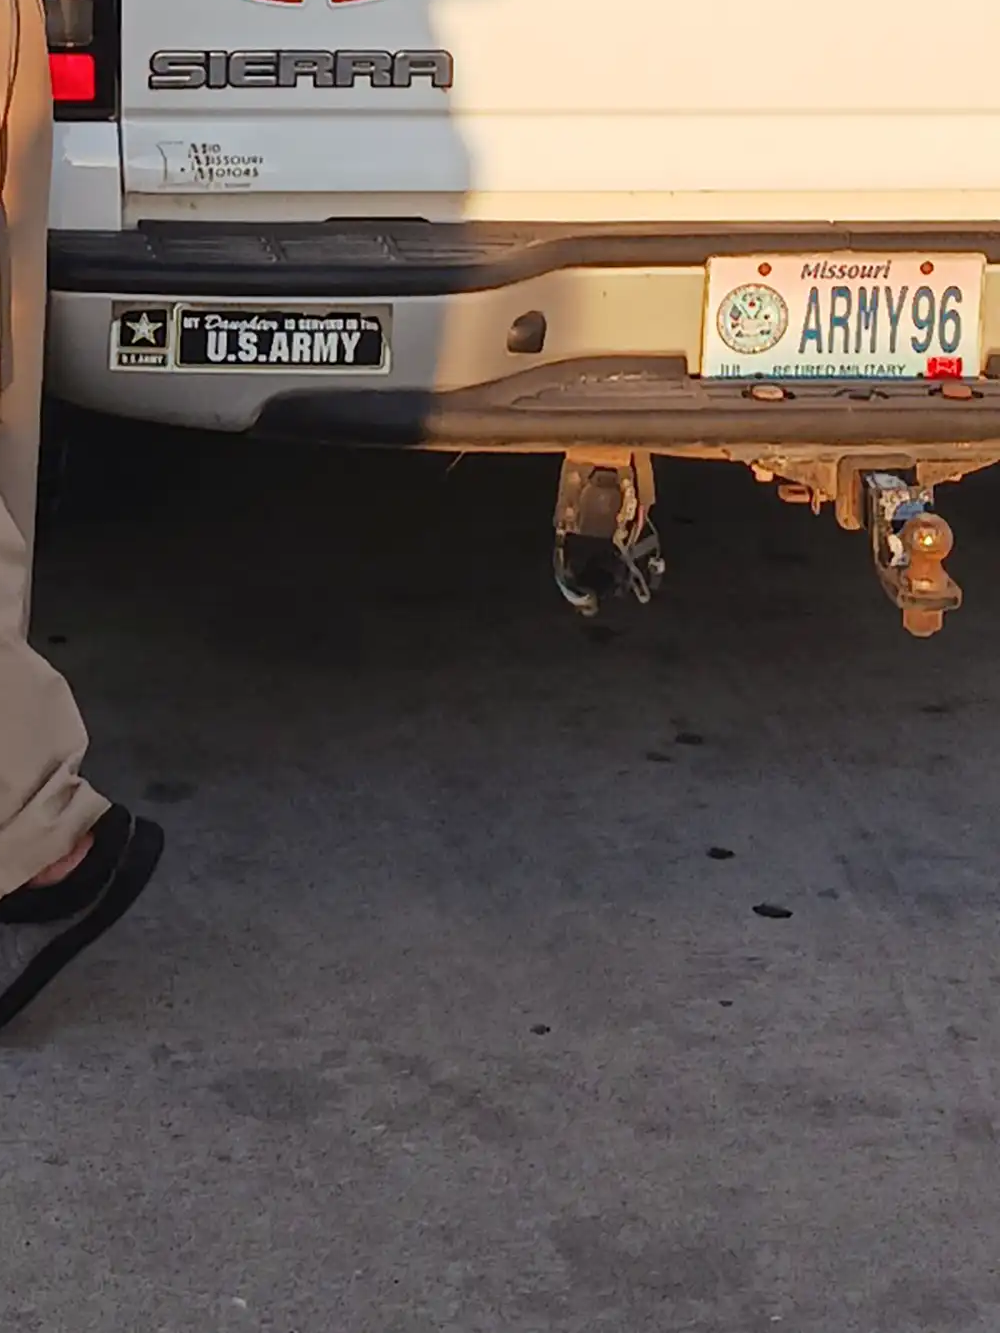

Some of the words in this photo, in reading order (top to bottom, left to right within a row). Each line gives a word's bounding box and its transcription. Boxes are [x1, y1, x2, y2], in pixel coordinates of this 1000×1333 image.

[147, 49, 454, 90] SIERRA
[800, 259, 892, 281] Missouri
[797, 284, 964, 355] ARMY96
[772, 363, 835, 378] RETIRED
[838, 363, 907, 377] MILITARY
